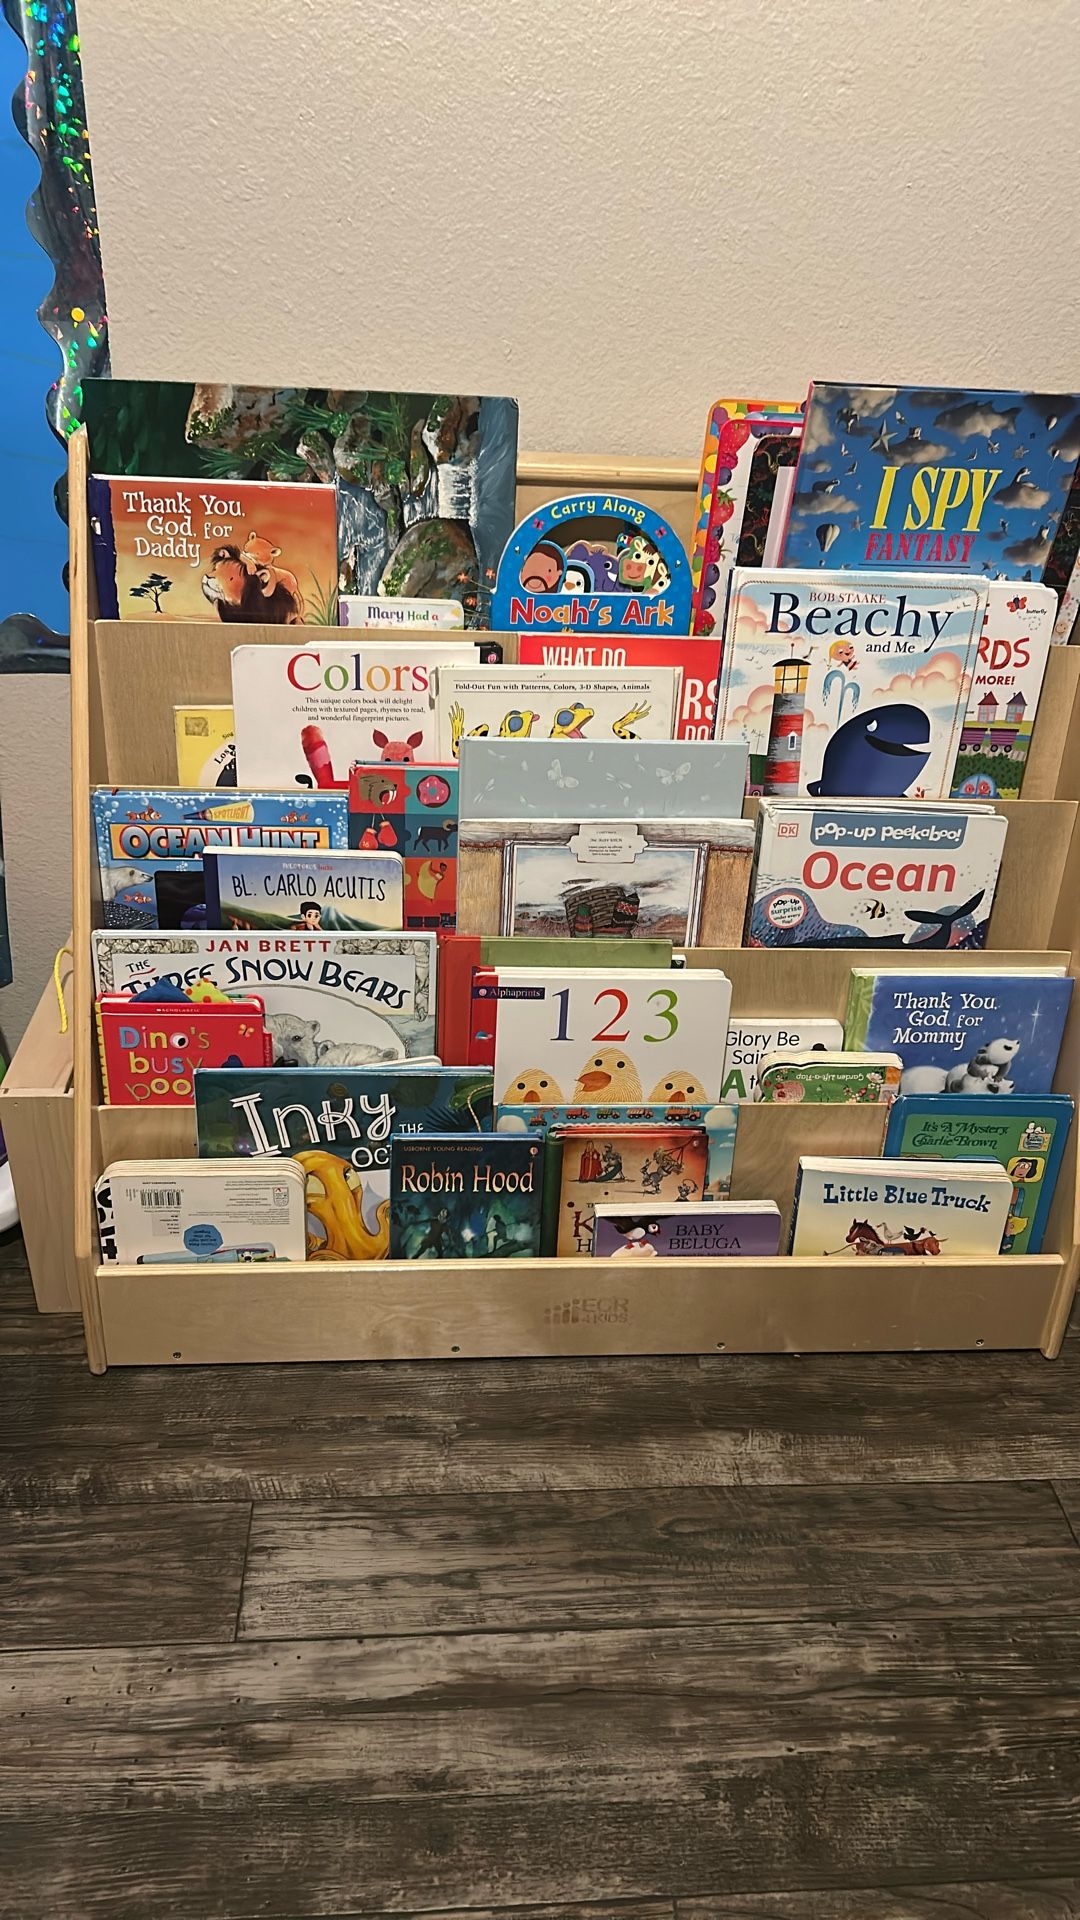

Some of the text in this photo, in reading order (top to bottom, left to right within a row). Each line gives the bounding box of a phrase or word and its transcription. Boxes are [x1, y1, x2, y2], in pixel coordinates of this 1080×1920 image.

[122, 490, 192, 515] Thank
[869, 466, 1003, 532] I SPY
[551, 498, 646, 524] Carry Along
[204, 520, 233, 540] for
[135, 537, 200, 567] Daddy
[864, 533, 976, 563] FANTASY
[809, 592, 887, 604] BOB STAAKE
[367, 606, 439, 623] Mary Had a
[509, 597, 675, 626] Noah's Ark
[765, 591, 954, 653] Beachy
[1026, 608, 1047, 616] butterfly
[542, 646, 627, 667] WHAT DO
[866, 641, 916, 654] and Me
[977, 636, 1030, 670] RDS
[287, 652, 429, 692] Colors
[975, 675, 1015, 686] MORE!
[455, 683, 485, 691] Fold-Out
[487, 683, 501, 691] Fun
[503, 683, 519, 691] with
[521, 683, 551, 692] Patterns,
[553, 683, 577, 692] Colors,
[593, 684, 619, 692] Shapes,
[292, 705, 318, 713] children
[380, 706, 402, 714] rhymes
[320, 697, 341, 705] unique
[392, 697, 413, 705] delight
[353, 714, 385, 722] fingerprint
[781, 825, 796, 836] DK
[120, 825, 321, 859] OCEAN HUNT
[802, 851, 957, 893] Ocean
[264, 873, 317, 897] CARLO
[323, 875, 387, 901] ACUTIS
[771, 905, 802, 915] surprise
[206, 939, 332, 953] JAN BRETT
[125, 959, 151, 973] THE
[226, 956, 314, 984] SNOW
[318, 960, 411, 1009] BEARS
[490, 988, 541, 998] Alphaprints
[893, 992, 951, 1010] Thank
[550, 987, 679, 1043] 1 2 3
[956, 1014, 984, 1029] for
[118, 1025, 210, 1050] Dino's
[726, 1030, 800, 1051] Glory Be
[892, 1028, 968, 1051] Mommy
[129, 1051, 204, 1075] busy
[732, 1049, 768, 1065] Sai
[720, 1069, 747, 1099] A
[836, 1073, 865, 1082] Garden
[125, 1078, 195, 1102] boo
[230, 1092, 396, 1158] Inky
[922, 1121, 938, 1133] It's
[940, 1122, 953, 1133] A
[912, 1133, 999, 1150] Charlie Brown
[401, 1161, 534, 1193] Robin Hood
[823, 1183, 992, 1213] Little Blue Truck
[676, 1224, 725, 1236] BABY
[669, 1237, 742, 1250] BELUGA
